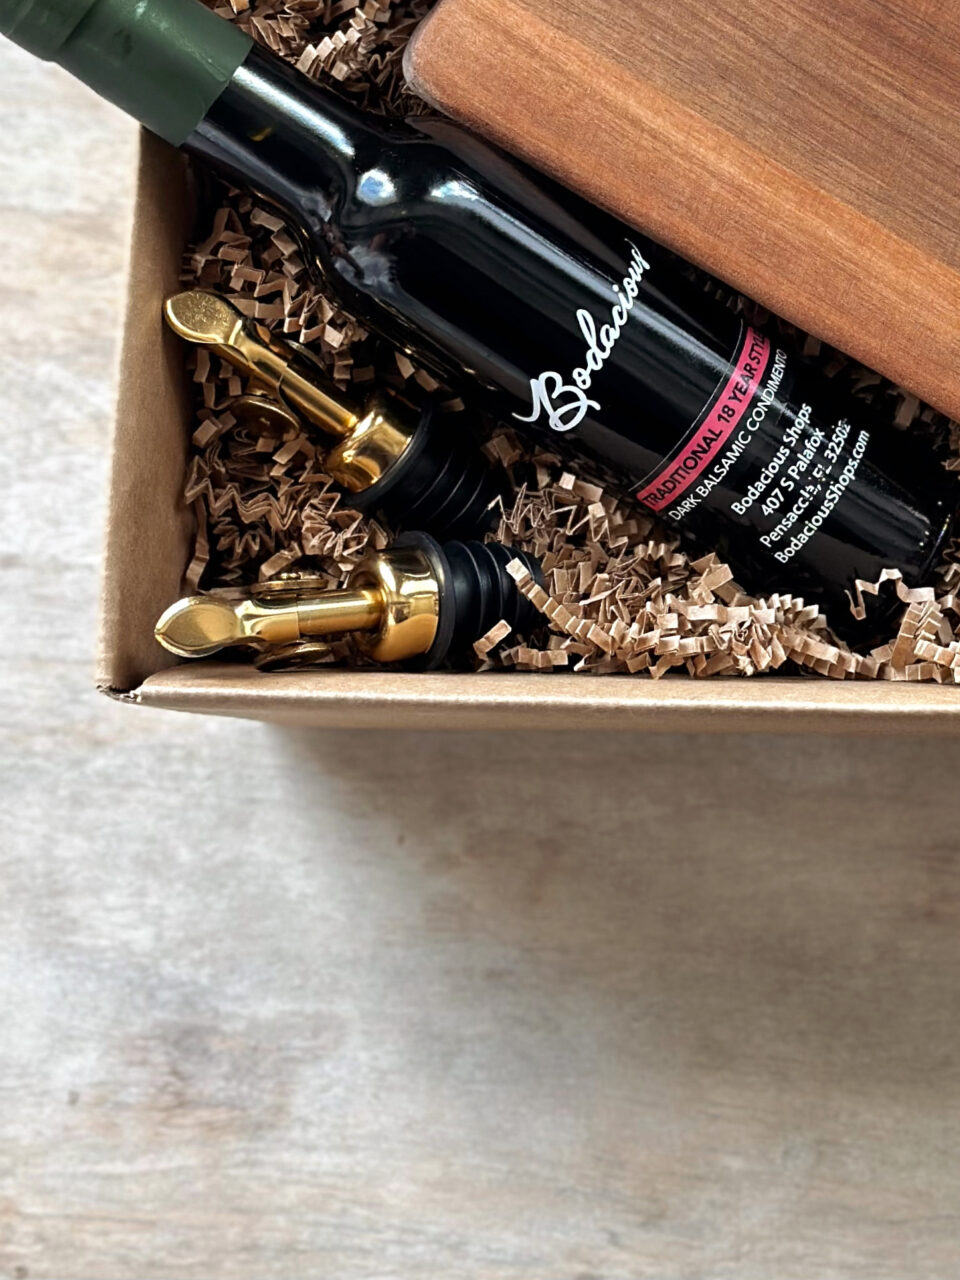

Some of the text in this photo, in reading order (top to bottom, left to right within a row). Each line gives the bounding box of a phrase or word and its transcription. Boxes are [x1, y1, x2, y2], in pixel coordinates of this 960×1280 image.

[511, 238, 651, 432] Bodacious
[641, 428, 723, 507] TRADITIONAL
[717, 404, 736, 424] 18
[728, 362, 758, 404] YEAR
[668, 348, 788, 521] DARK BALSAMIC CONDIMENTO
[730, 402, 813, 516] Bodacious Shops
[761, 427, 826, 517] 407 S Palafox
[774, 429, 871, 564] BodaciousShops.com
